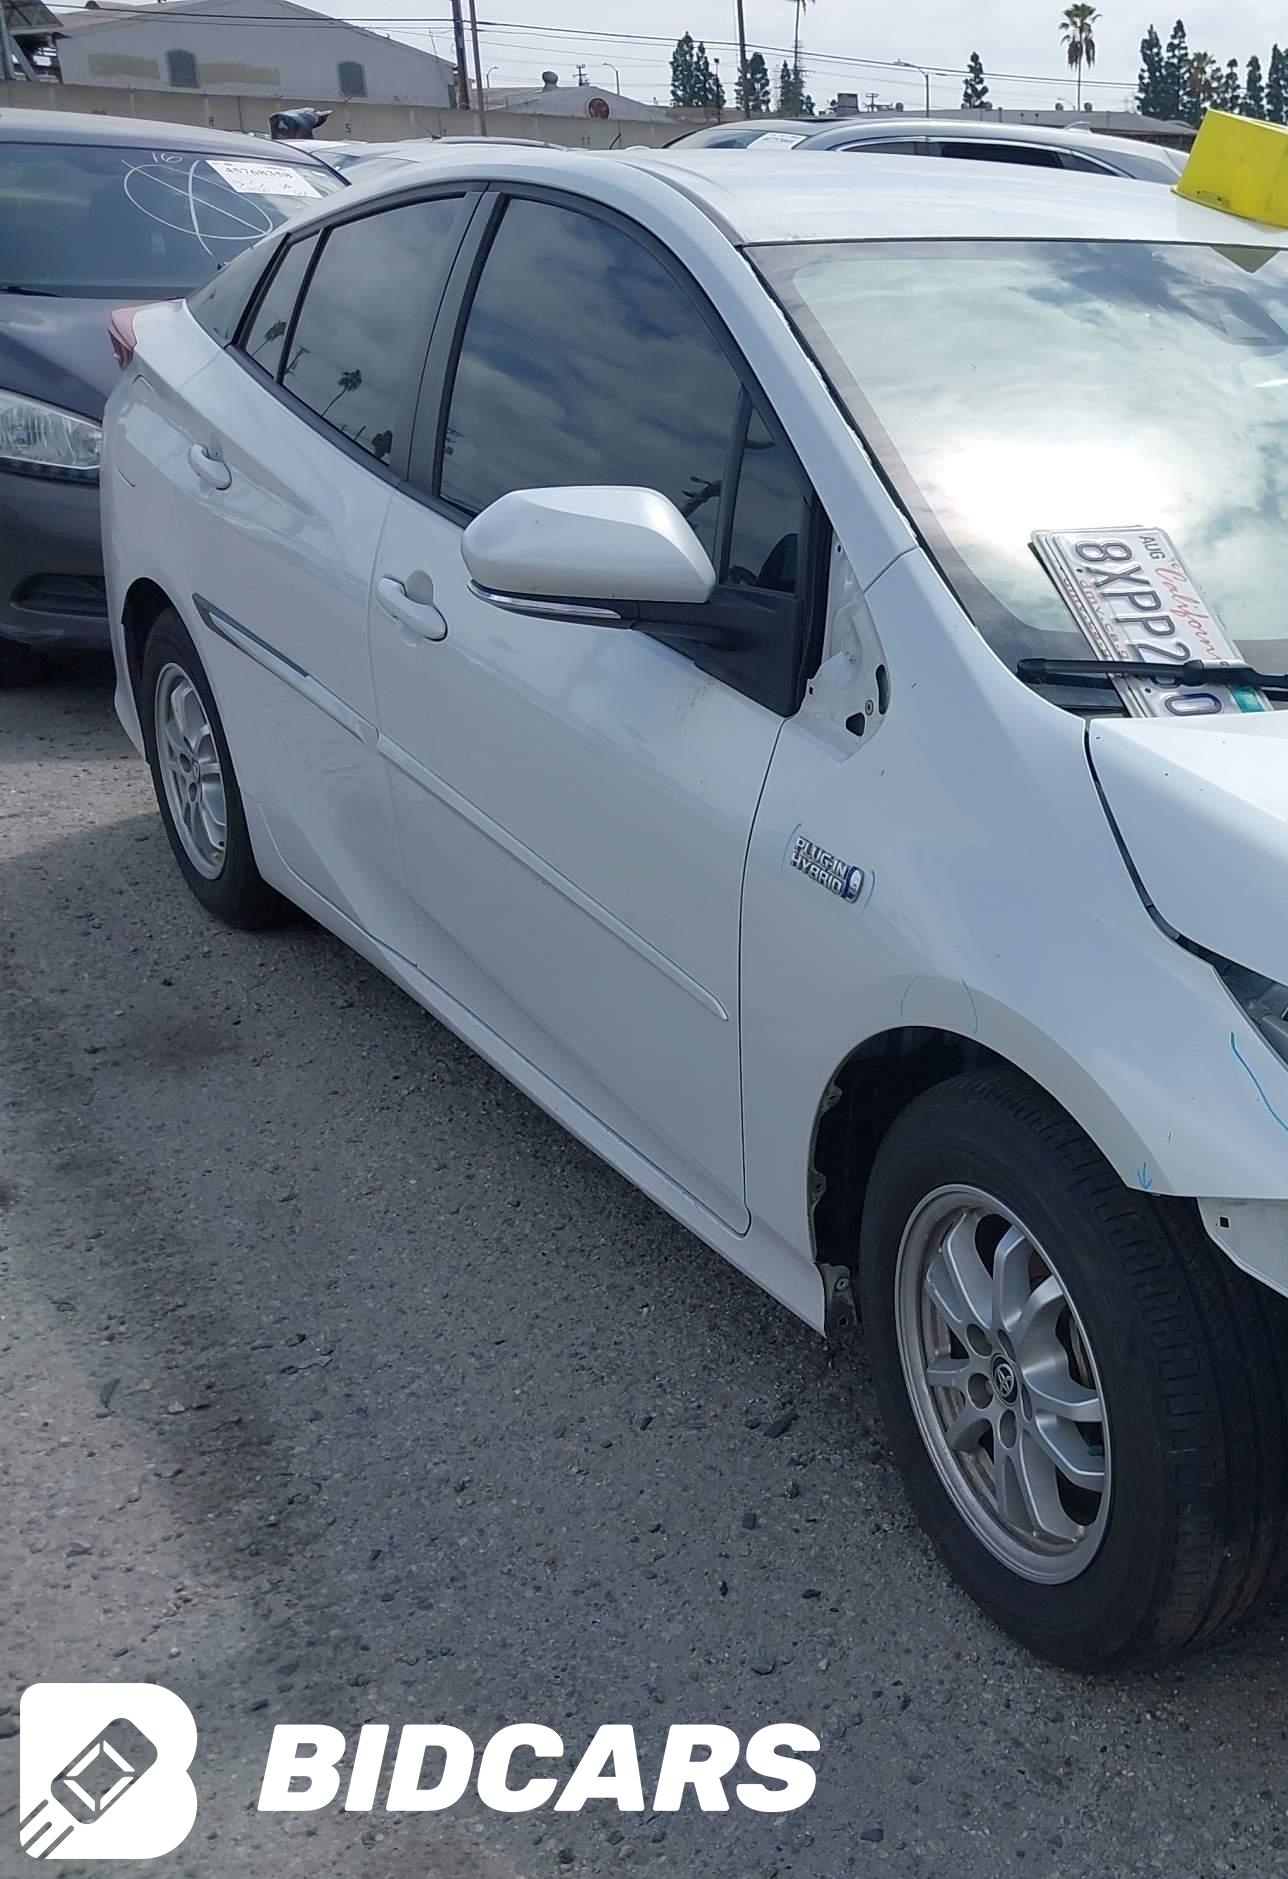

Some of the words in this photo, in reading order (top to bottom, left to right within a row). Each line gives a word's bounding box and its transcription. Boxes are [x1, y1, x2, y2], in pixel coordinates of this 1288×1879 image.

[1139, 535, 1166, 561] AUG
[1155, 566, 1222, 660] Californ
[789, 851, 844, 896] HYBRID
